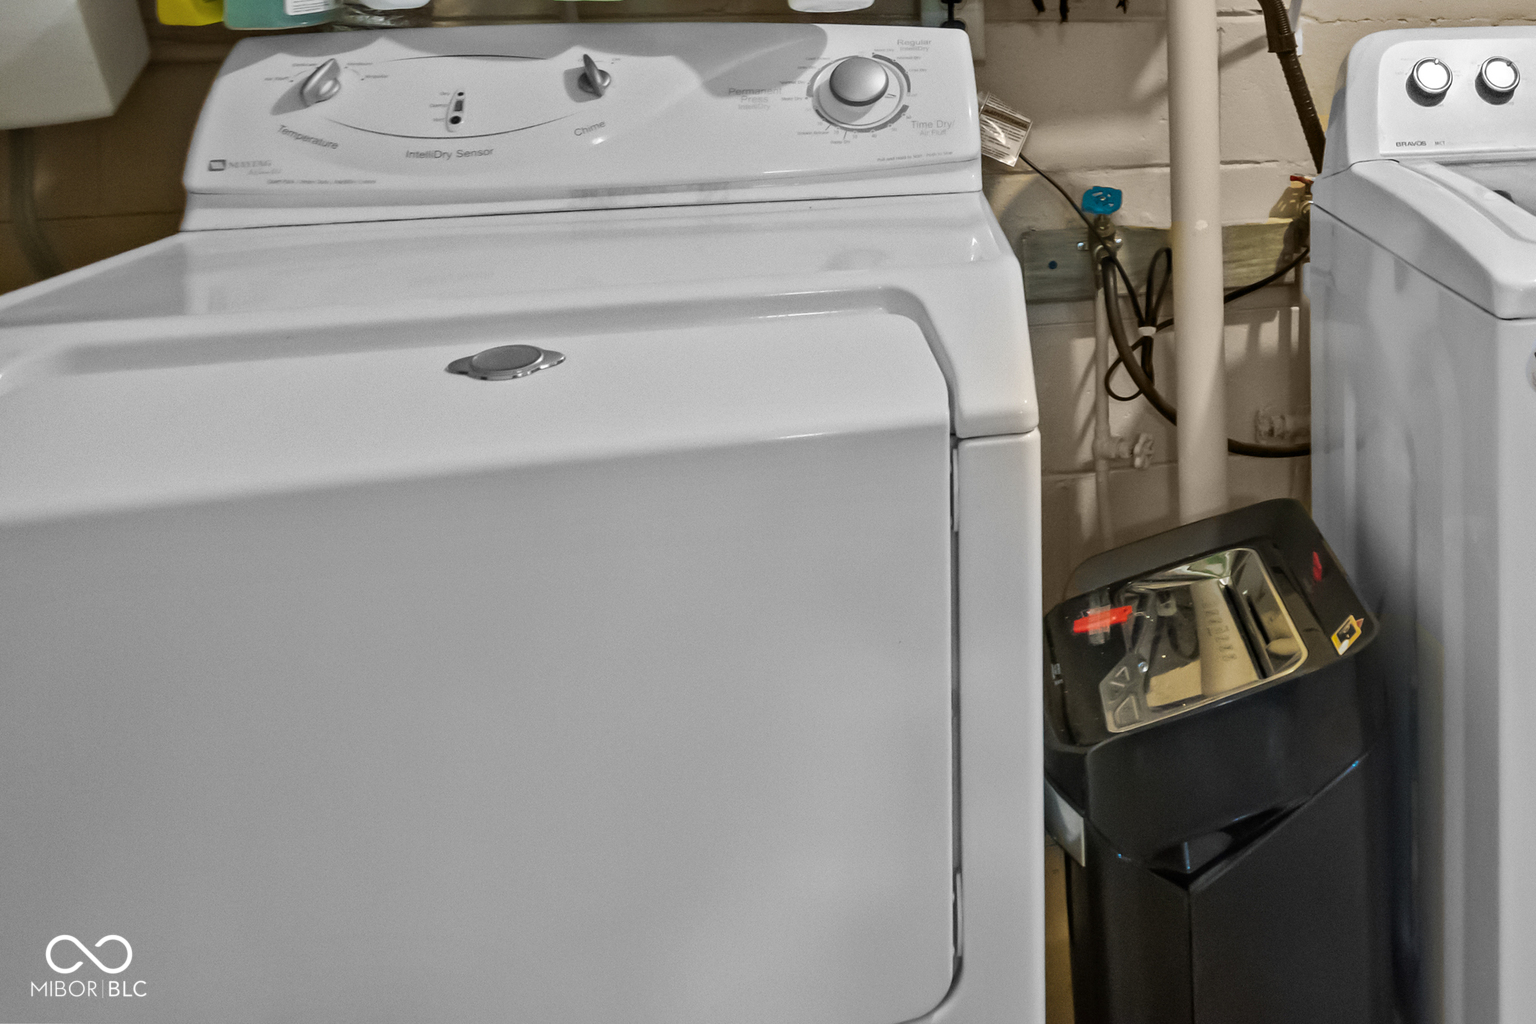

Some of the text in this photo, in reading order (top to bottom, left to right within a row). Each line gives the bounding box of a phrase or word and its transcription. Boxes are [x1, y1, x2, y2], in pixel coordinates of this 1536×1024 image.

[897, 39, 932, 47] Regular
[573, 121, 606, 137] Chime
[911, 120, 933, 129] Time
[277, 124, 339, 150] Temperature
[405, 148, 494, 160] IntelliDry Sensor
